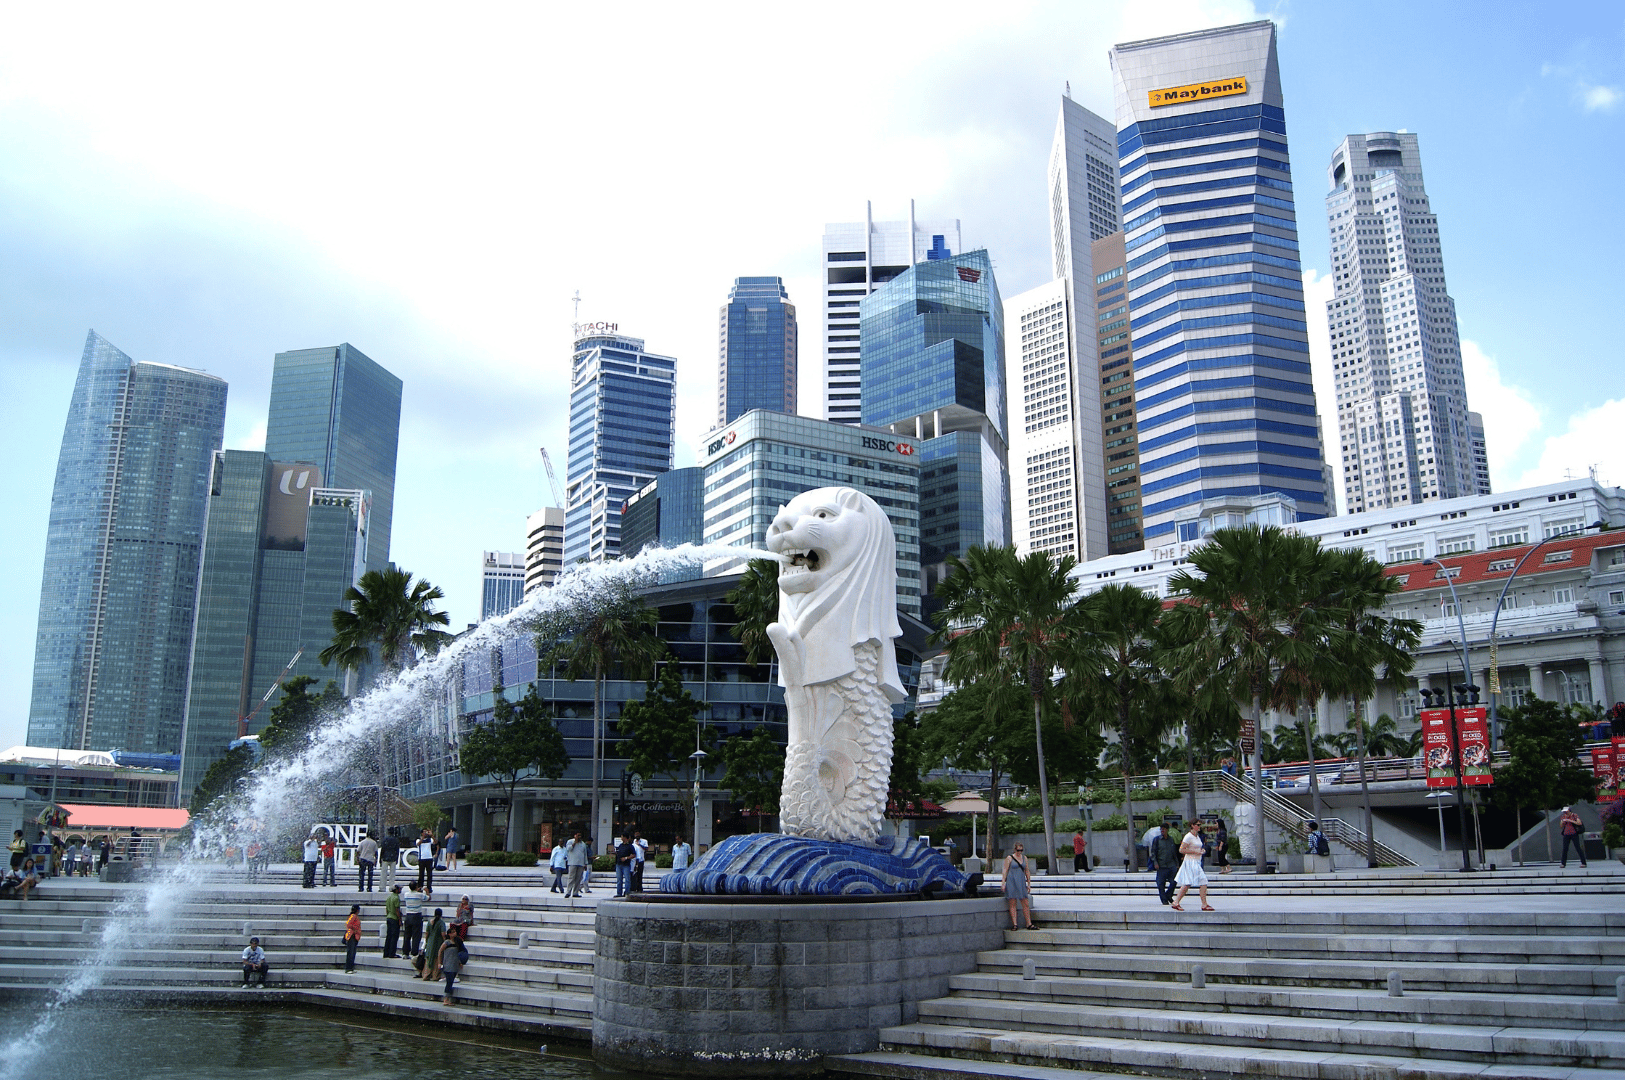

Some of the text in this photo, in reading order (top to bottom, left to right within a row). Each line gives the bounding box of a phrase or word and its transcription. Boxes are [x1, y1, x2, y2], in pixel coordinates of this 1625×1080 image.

[1164, 82, 1243, 100] Maybank
[708, 435, 726, 456] HSBC
[862, 435, 896, 453] HSBC
[1150, 547, 1176, 561] THE
[642, 802, 671, 811] Coffee
[311, 824, 368, 845] ONE
